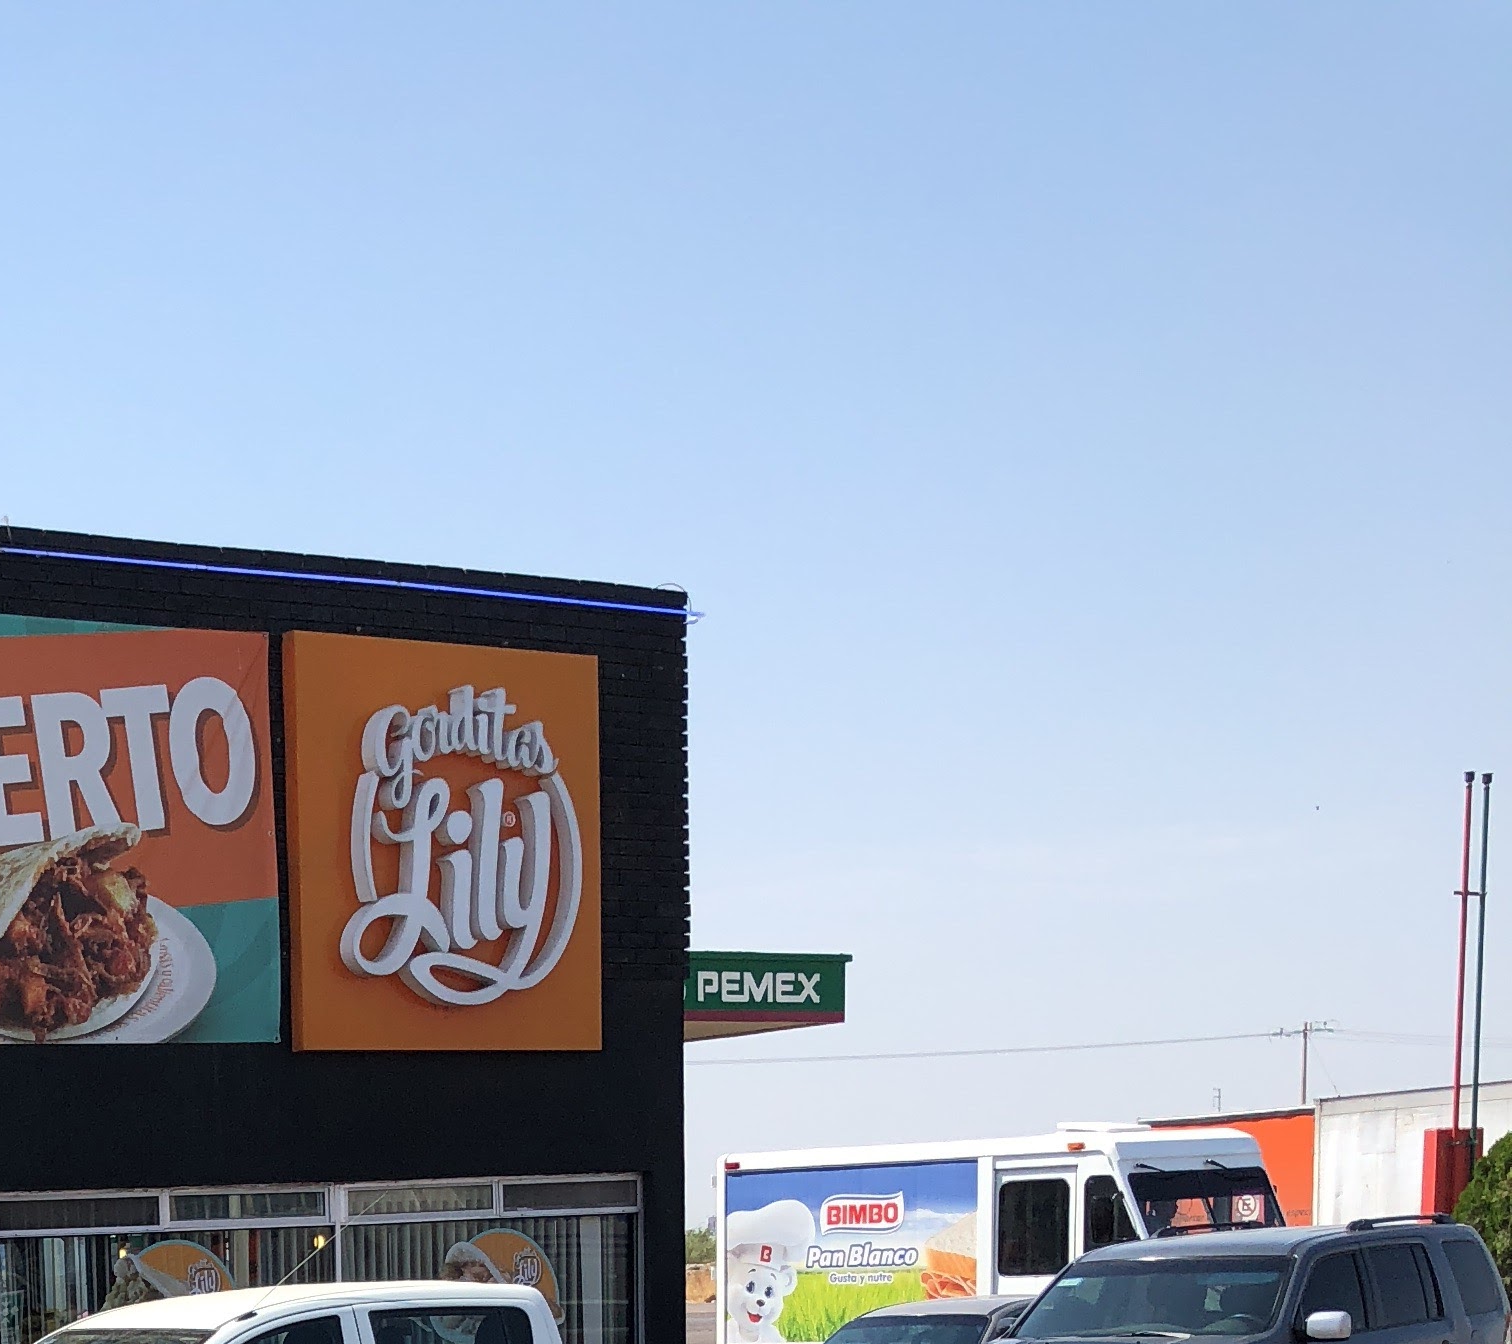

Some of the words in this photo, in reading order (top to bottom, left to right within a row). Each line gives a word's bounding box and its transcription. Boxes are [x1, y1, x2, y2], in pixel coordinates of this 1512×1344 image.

[361, 685, 559, 809] Gorditas
[340, 776, 582, 1005] Lily
[697, 970, 821, 1004] PEMEX
[826, 1202, 899, 1226] BIMBO
[806, 1245, 844, 1268] Pan
[847, 1242, 919, 1268] Blanco
[829, 1273, 857, 1283] Gusta
[859, 1275, 865, 1285] y
[867, 1273, 893, 1282] nutre
